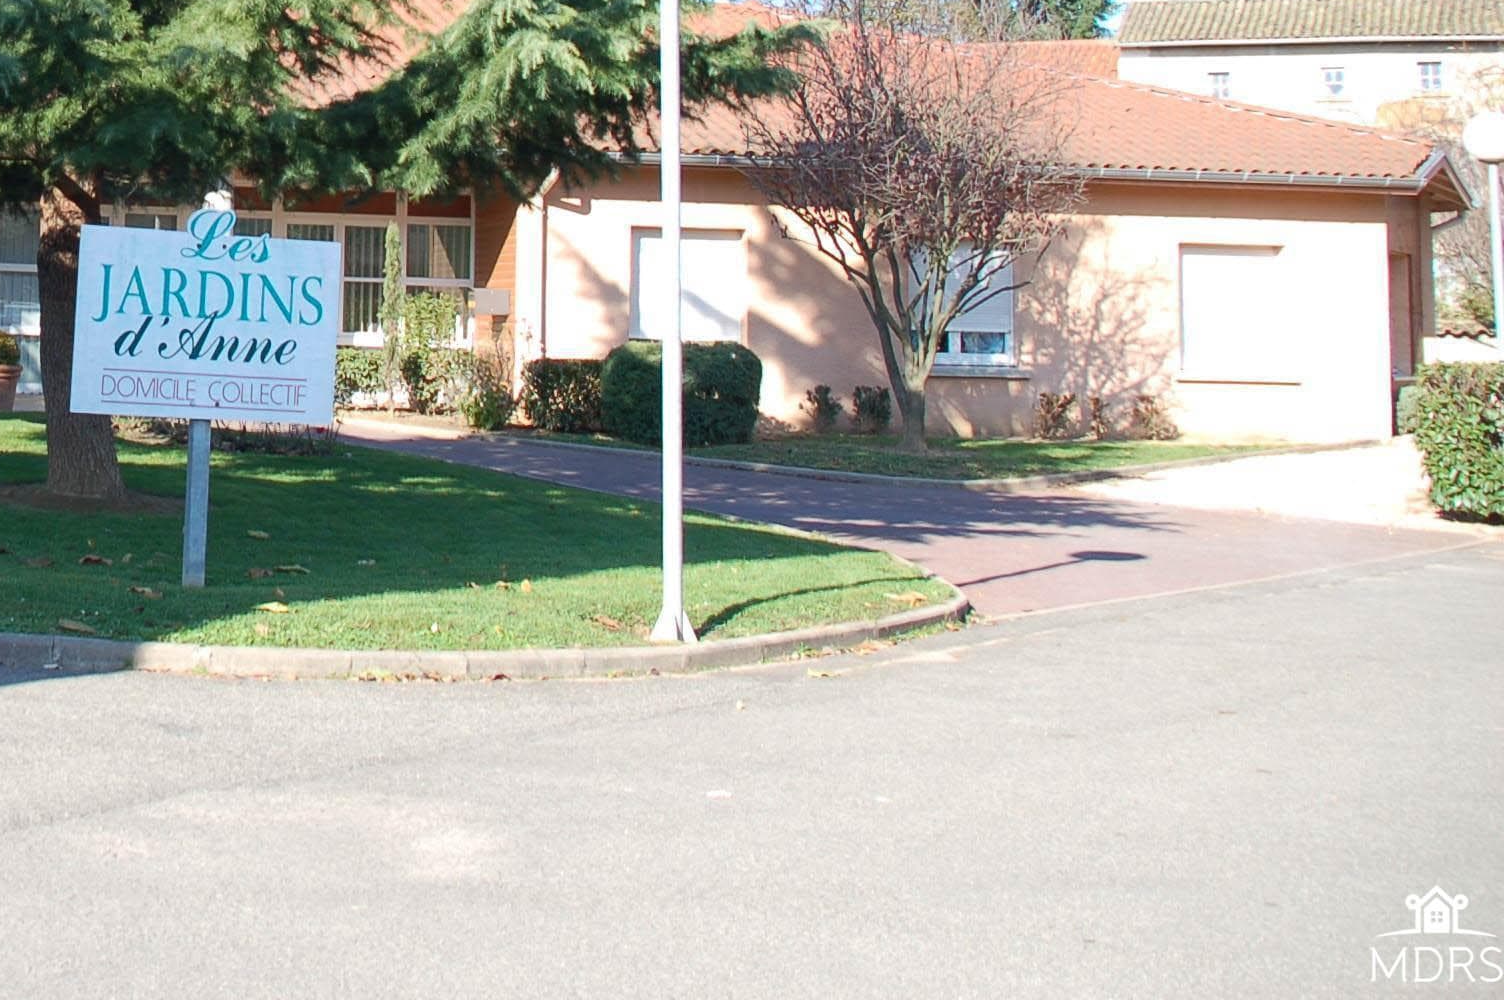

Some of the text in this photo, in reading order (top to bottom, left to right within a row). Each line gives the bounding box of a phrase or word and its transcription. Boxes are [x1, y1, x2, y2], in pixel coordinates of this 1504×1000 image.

[180, 209, 271, 263] Les
[91, 263, 324, 326] JARDINS
[114, 310, 298, 365] d'Anne
[100, 374, 308, 407] DOMICILE COLLECTIF
